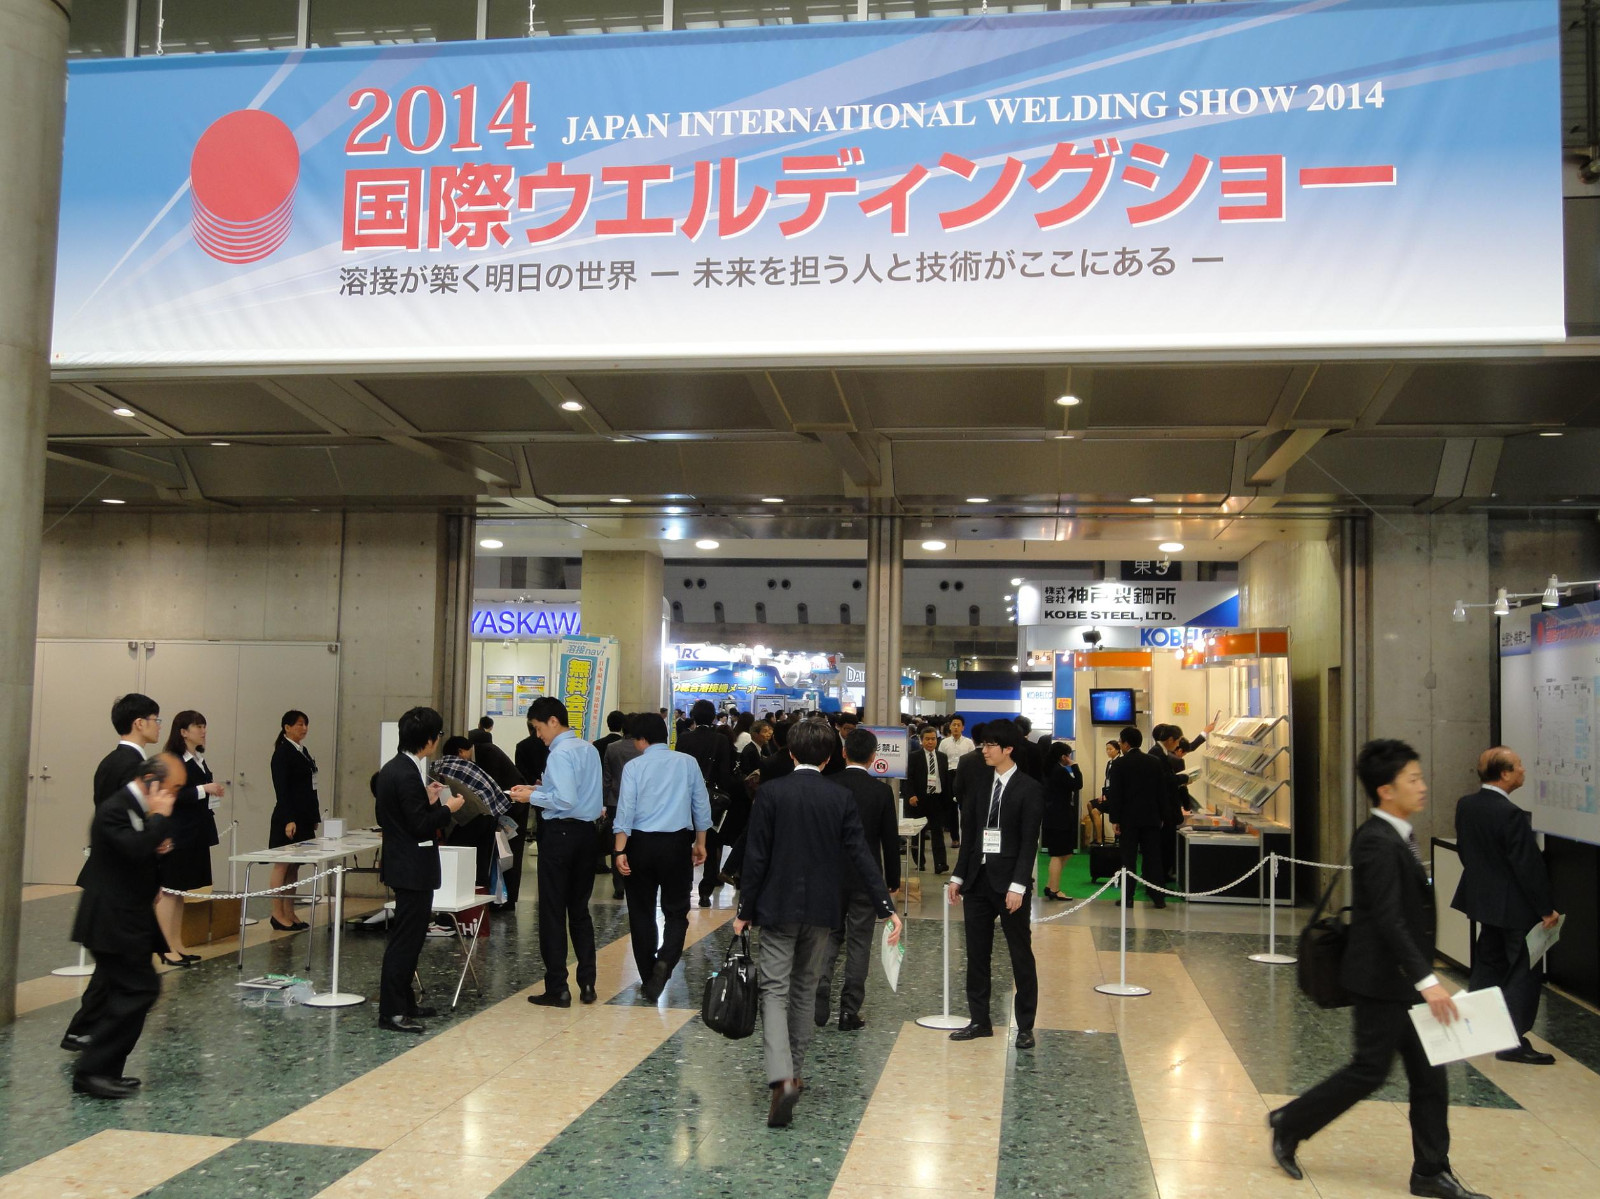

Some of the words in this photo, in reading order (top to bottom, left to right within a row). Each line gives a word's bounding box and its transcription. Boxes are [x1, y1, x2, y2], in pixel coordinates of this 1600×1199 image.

[345, 81, 536, 155] 2014
[562, 112, 669, 145] JAPAN
[678, 99, 977, 137] INTERNATIONAL
[985, 89, 1170, 125] WELDING
[1178, 85, 1298, 117] SHOW
[1306, 81, 1386, 112] 2014
[342, 136, 1397, 253] 国際ウエルディングショー
[339, 259, 638, 296] 溶接が築く明日の世界
[693, 246, 1177, 289] 未来を担う人と技術がここにある
[470, 610, 581, 636] YASKAW
[1044, 610, 1088, 620] KOBE
[1090, 611, 1144, 622] STEEL,
[1145, 611, 1177, 621] LTD.
[564, 658, 592, 740] 無料会員
